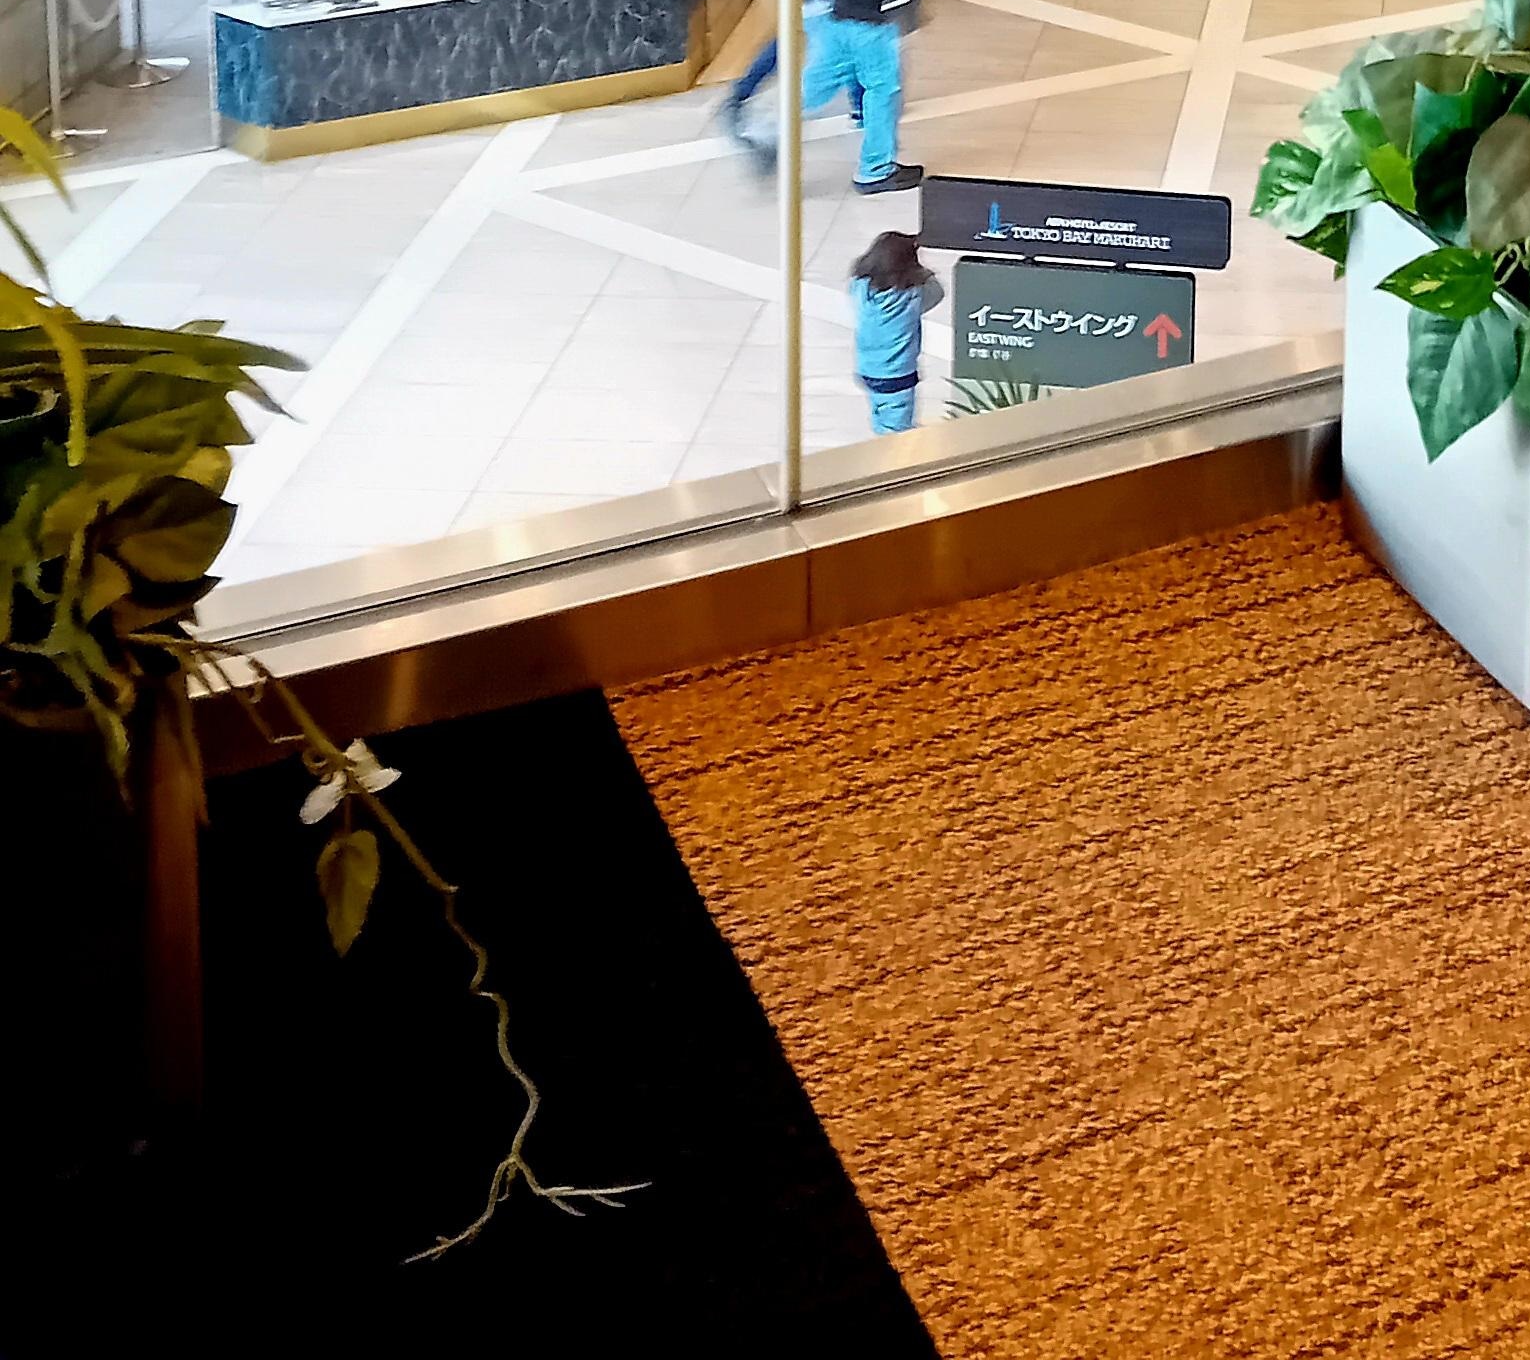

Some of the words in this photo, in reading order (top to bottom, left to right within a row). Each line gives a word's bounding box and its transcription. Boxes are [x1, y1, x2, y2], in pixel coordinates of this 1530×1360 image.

[1011, 227, 1060, 241] TOKYO
[1063, 230, 1091, 244] BAY
[1093, 233, 1171, 250] MAKUHARI
[969, 305, 1139, 338] イーストウイング
[968, 332, 998, 345] EAST
[998, 334, 1034, 348] WING
